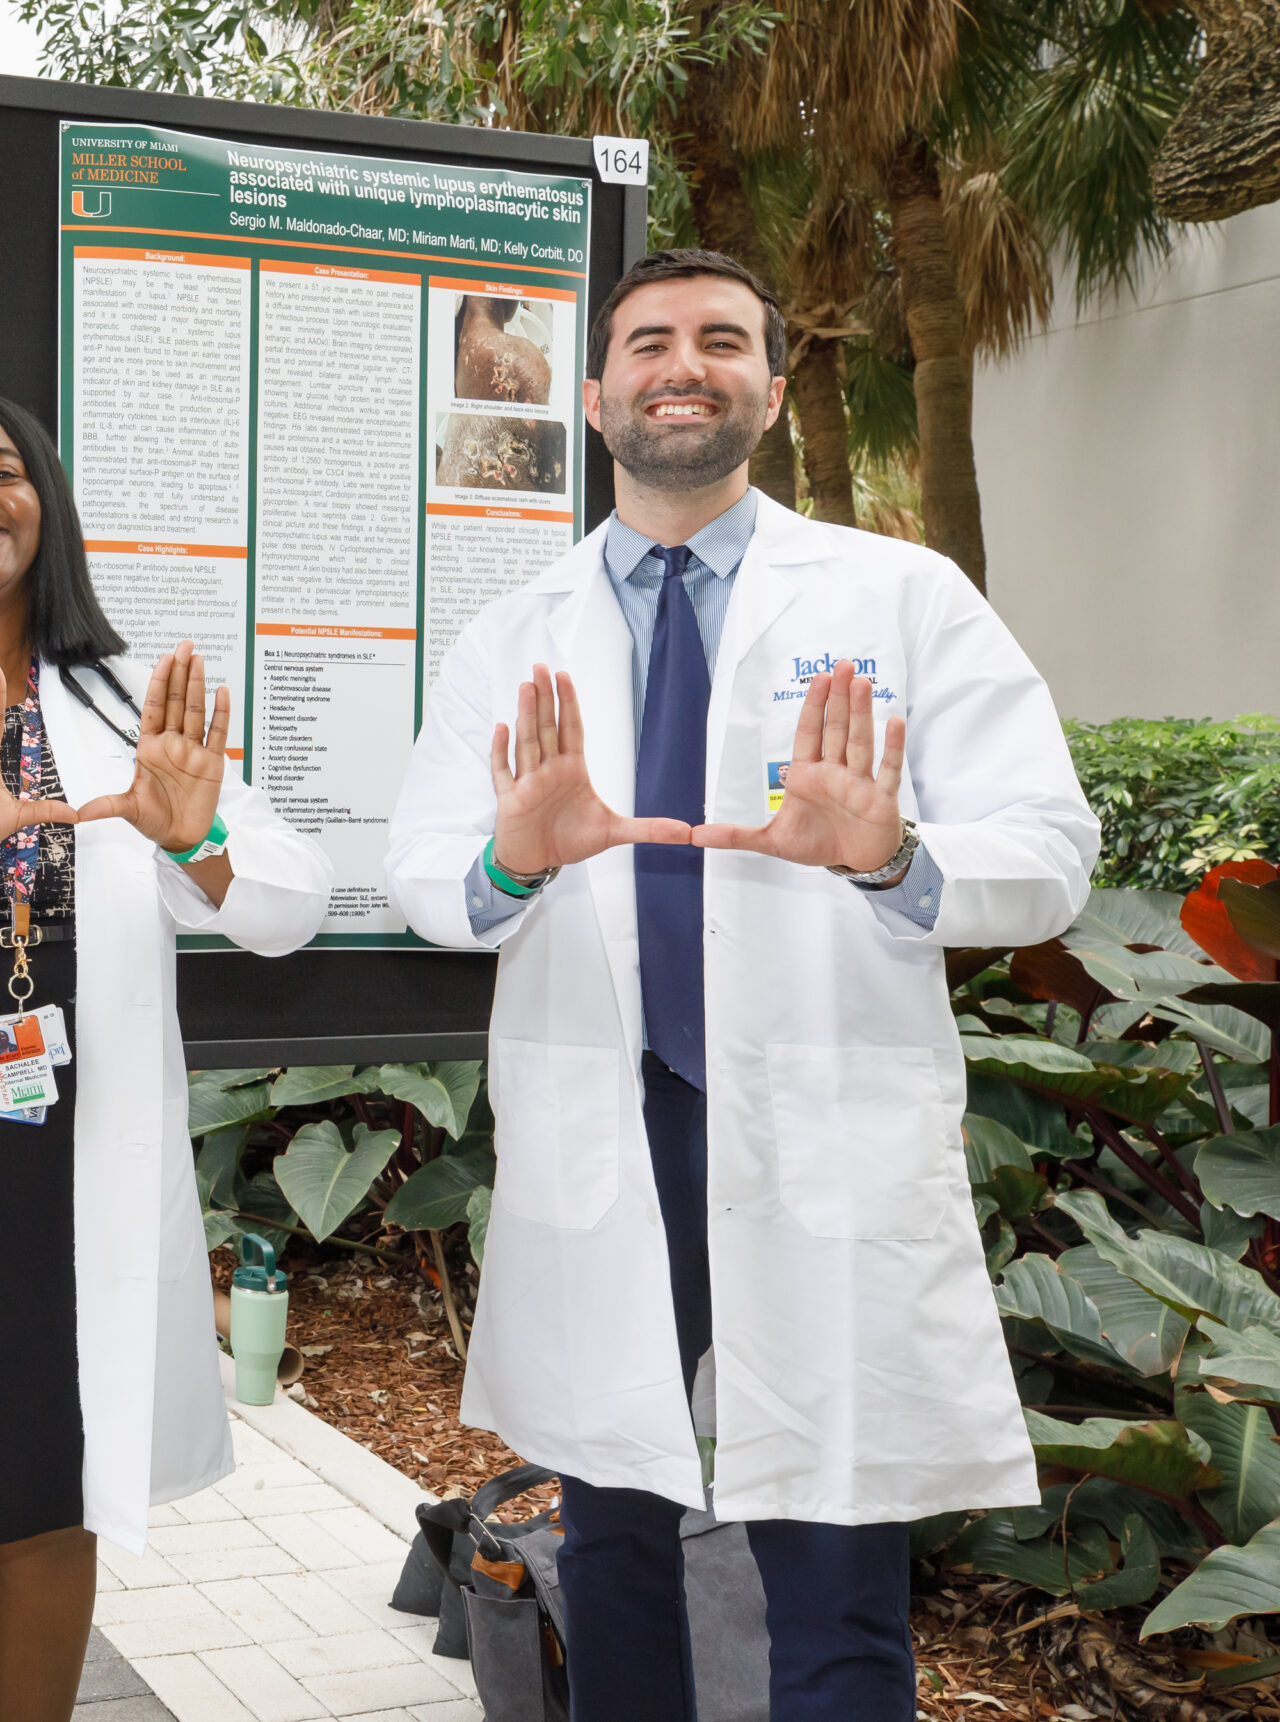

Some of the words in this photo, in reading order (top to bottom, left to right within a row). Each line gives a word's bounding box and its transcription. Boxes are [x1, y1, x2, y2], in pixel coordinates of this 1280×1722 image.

[72, 138, 133, 148] UNIVERSITY
[135, 140, 147, 149] OF
[150, 142, 178, 152] MIAMI
[72, 153, 127, 166] MILLER
[131, 155, 187, 171] SCHOOL
[601, 149, 642, 174] 164
[72, 168, 85, 180] of
[88, 169, 159, 184] MEDICINE
[228, 151, 359, 181] Neuropsychiatric
[362, 168, 430, 188] systemic
[434, 174, 475, 194] lupus
[480, 181, 584, 206] erythematosus
[230, 170, 314, 192] associated
[318, 178, 350, 197] with
[354, 185, 406, 204] unique
[410, 188, 549, 222] lymphoplasmacytic
[552, 206, 581, 224] skin
[231, 185, 287, 208] lesions
[230, 212, 266, 230] Sergio
[269, 216, 283, 229] M.
[287, 218, 385, 242] Maldonado-Chaar,
[388, 228, 409, 244] MD;
[413, 231, 447, 246] Miriam
[450, 235, 477, 252] Marti,
[481, 238, 501, 255] MD;
[504, 241, 528, 259] Kelly
[531, 244, 565, 262] Corbitt,
[568, 249, 583, 263] DO
[145, 252, 185, 262] Background:
[315, 266, 329, 275] Case
[331, 268, 369, 278] Presentation:
[498, 286, 524, 296] Findings:
[486, 508, 522, 517] Conclusions:
[155, 545, 188, 554] Highlights:
[340, 629, 383, 637] Manifestations:
[790, 653, 877, 682] Jackon
[5, 1059, 40, 1071] SACHALEE
[3, 1068, 35, 1079] CAMPBELL
